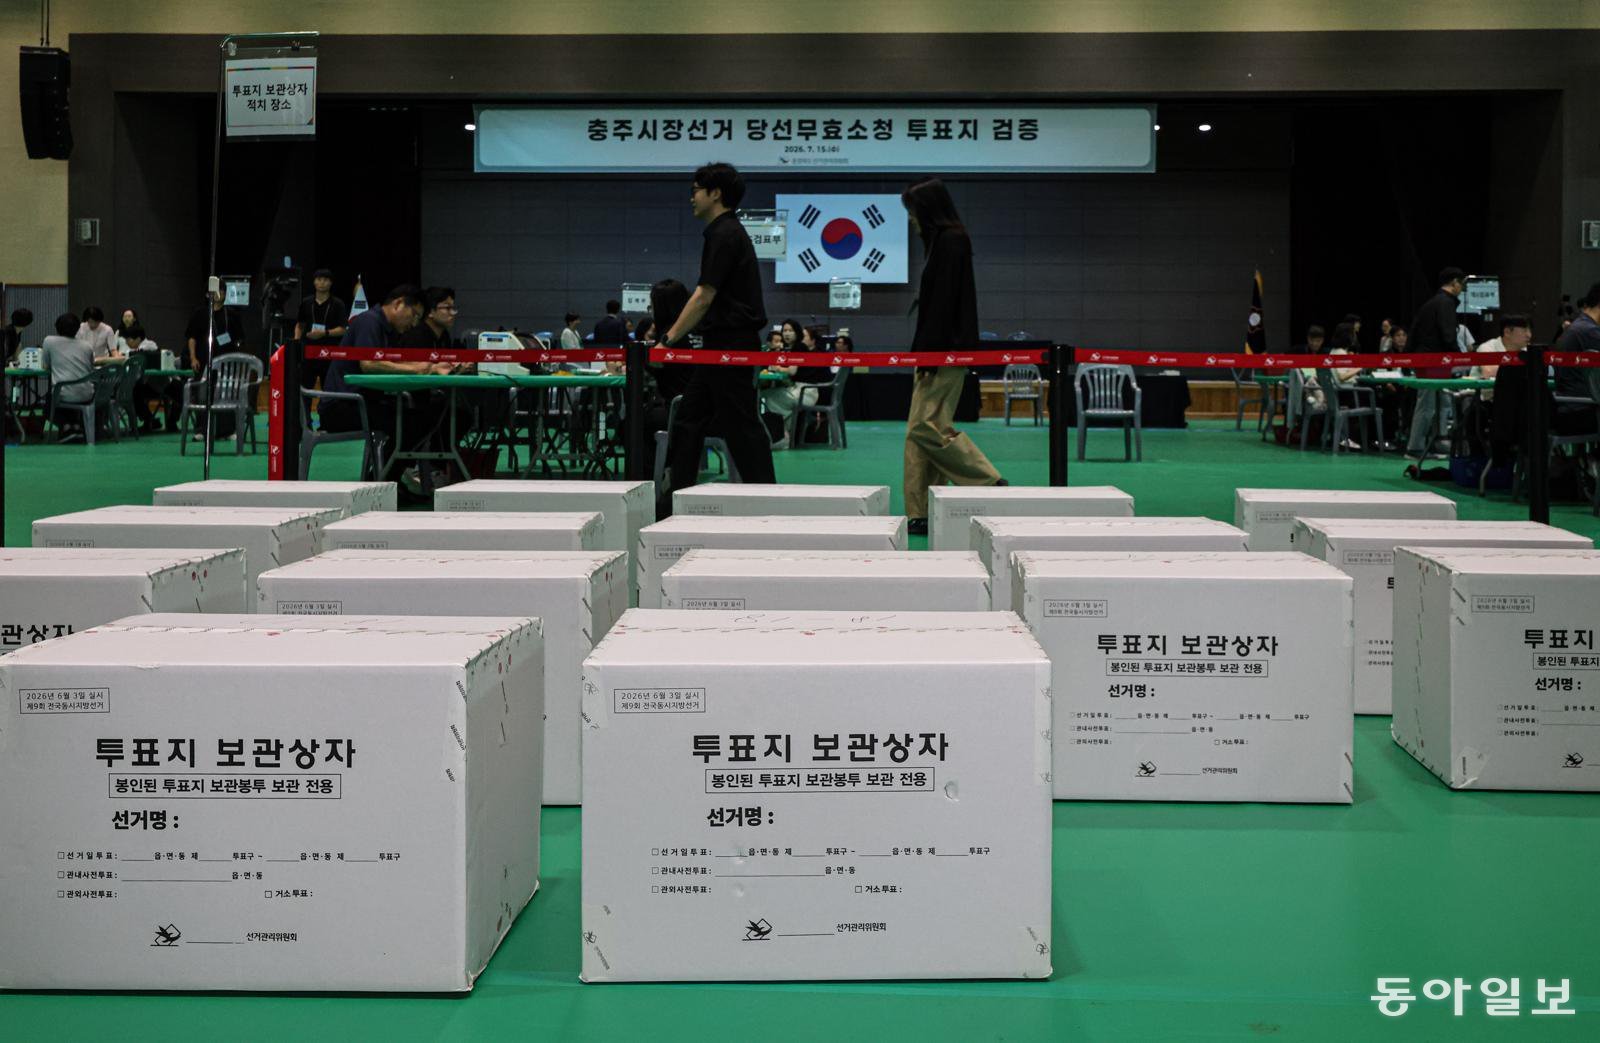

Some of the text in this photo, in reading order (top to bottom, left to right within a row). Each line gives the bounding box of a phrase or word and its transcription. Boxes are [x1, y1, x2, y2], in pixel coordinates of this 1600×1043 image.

[232, 83, 308, 97] 투표지 보관상자
[247, 98, 292, 111] 적치 장소
[587, 118, 1040, 142] 충주시장선거 당선무효소청 투표지 검증
[749, 234, 782, 245] 검표부
[1098, 634, 1279, 657] 투표지 보관상자
[1524, 629, 1593, 650] 투표지
[1110, 662, 1263, 674] 봉인된 투표지 보관봉투 보관 전용
[1537, 656, 1600, 667] 봉인된 투표지
[1108, 684, 1147, 698] 선거명
[1535, 677, 1574, 692] 선거명
[26, 692, 104, 700] 2026년 6월 3일 실시
[621, 692, 650, 700] 2026년
[653, 692, 666, 700] 6월
[26, 702, 104, 711] 제9회 전국동시지방선거
[621, 701, 700, 710] 제9회 전국동시지방선거
[96, 738, 356, 769] 투표지 보관상자
[692, 733, 949, 763] 투표지 보관상자
[115, 778, 334, 793] 봉인된 투표지 보관봉투 보관 전용
[711, 772, 928, 788] 봉인된 투표지 보관봉투 보관 전용
[112, 809, 167, 830] 선거명
[706, 806, 762, 827] 선거명
[232, 852, 255, 861] 투표구
[378, 852, 401, 861] 투표구
[825, 847, 848, 856] 투표구
[969, 847, 991, 856] 투표구
[836, 922, 887, 933] 선거관리위원회
[246, 932, 298, 942] 선거관리위원회
